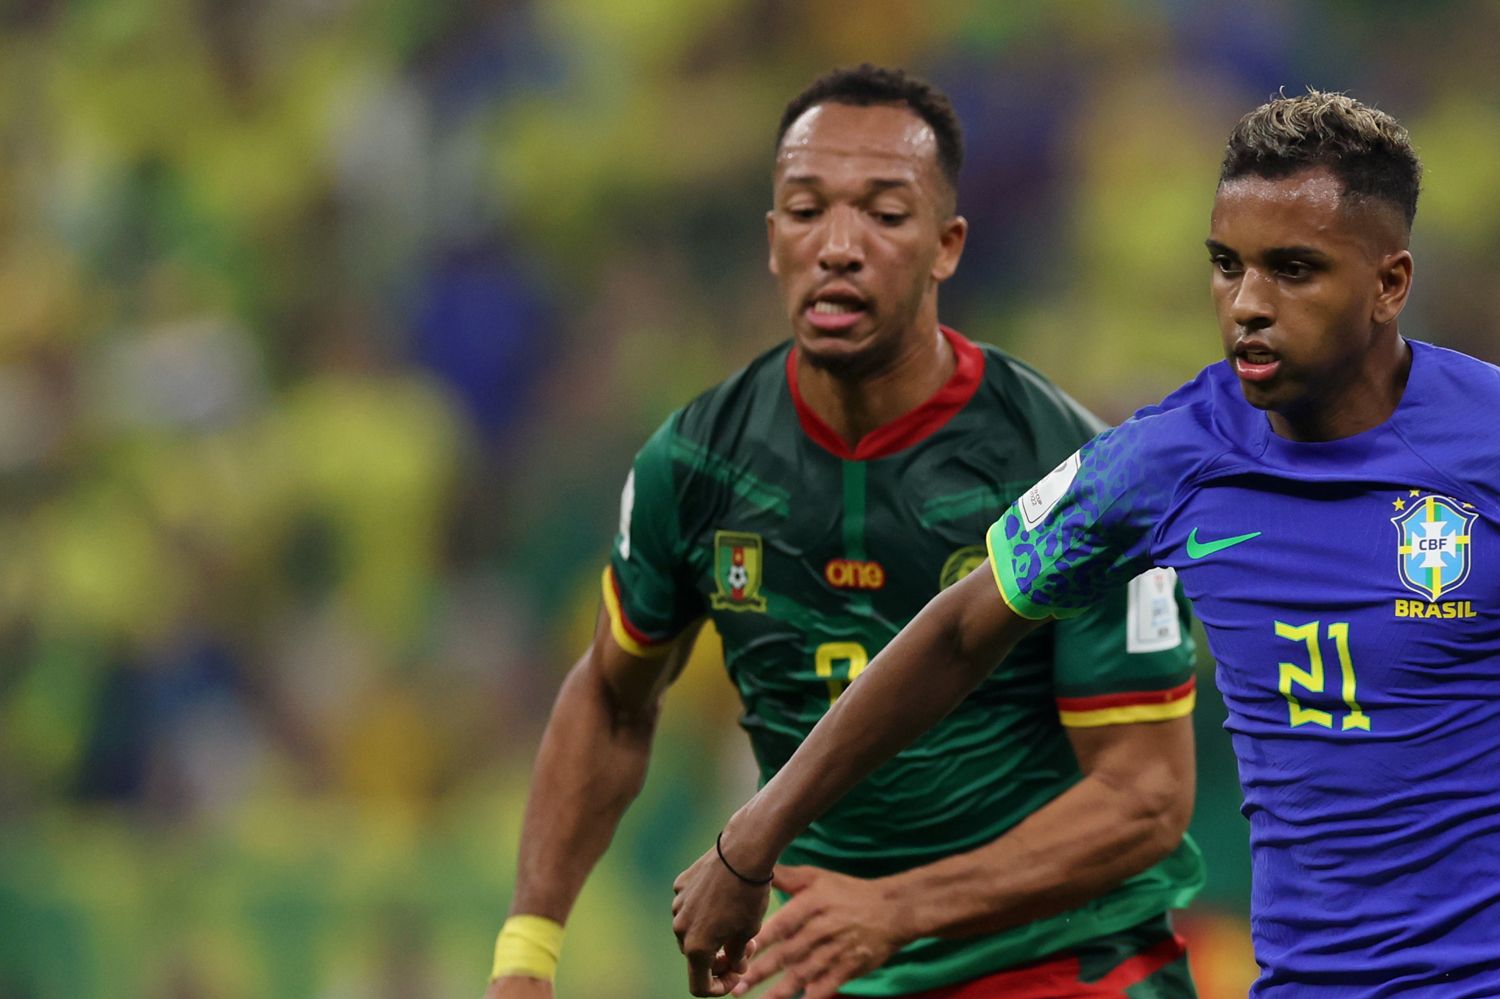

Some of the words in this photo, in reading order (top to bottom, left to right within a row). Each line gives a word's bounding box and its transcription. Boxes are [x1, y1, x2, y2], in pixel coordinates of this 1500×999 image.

[1419, 538, 1448, 551] CBF
[826, 560, 884, 588] one
[1395, 599, 1477, 619] BRASIL
[1274, 620, 1371, 731] 21
